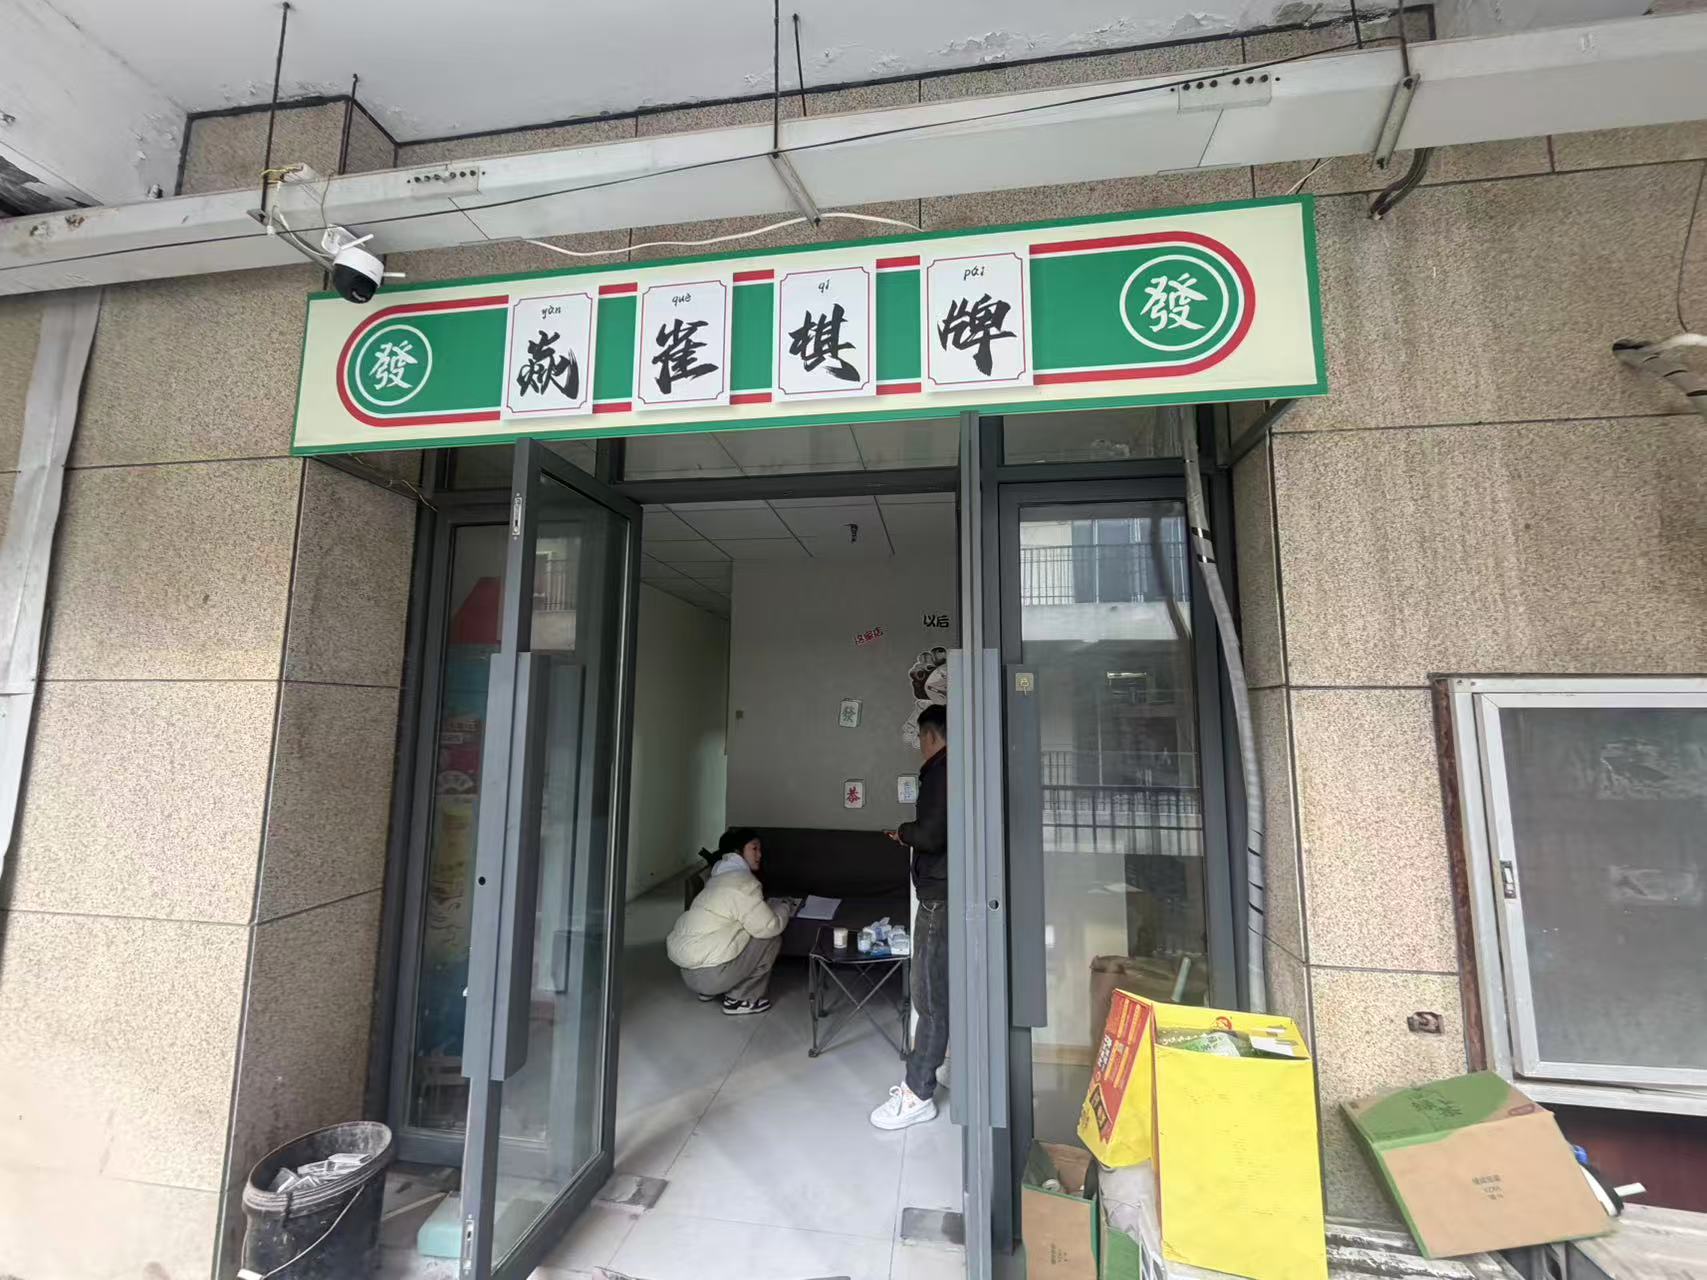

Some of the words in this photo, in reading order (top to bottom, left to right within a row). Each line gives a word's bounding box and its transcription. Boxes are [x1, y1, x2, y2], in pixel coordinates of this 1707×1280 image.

[541, 304, 562, 319] yàn
[671, 292, 692, 307] què
[1140, 272, 1208, 333] 發
[368, 339, 419, 391] 發
[923, 614, 950, 628] 以后
